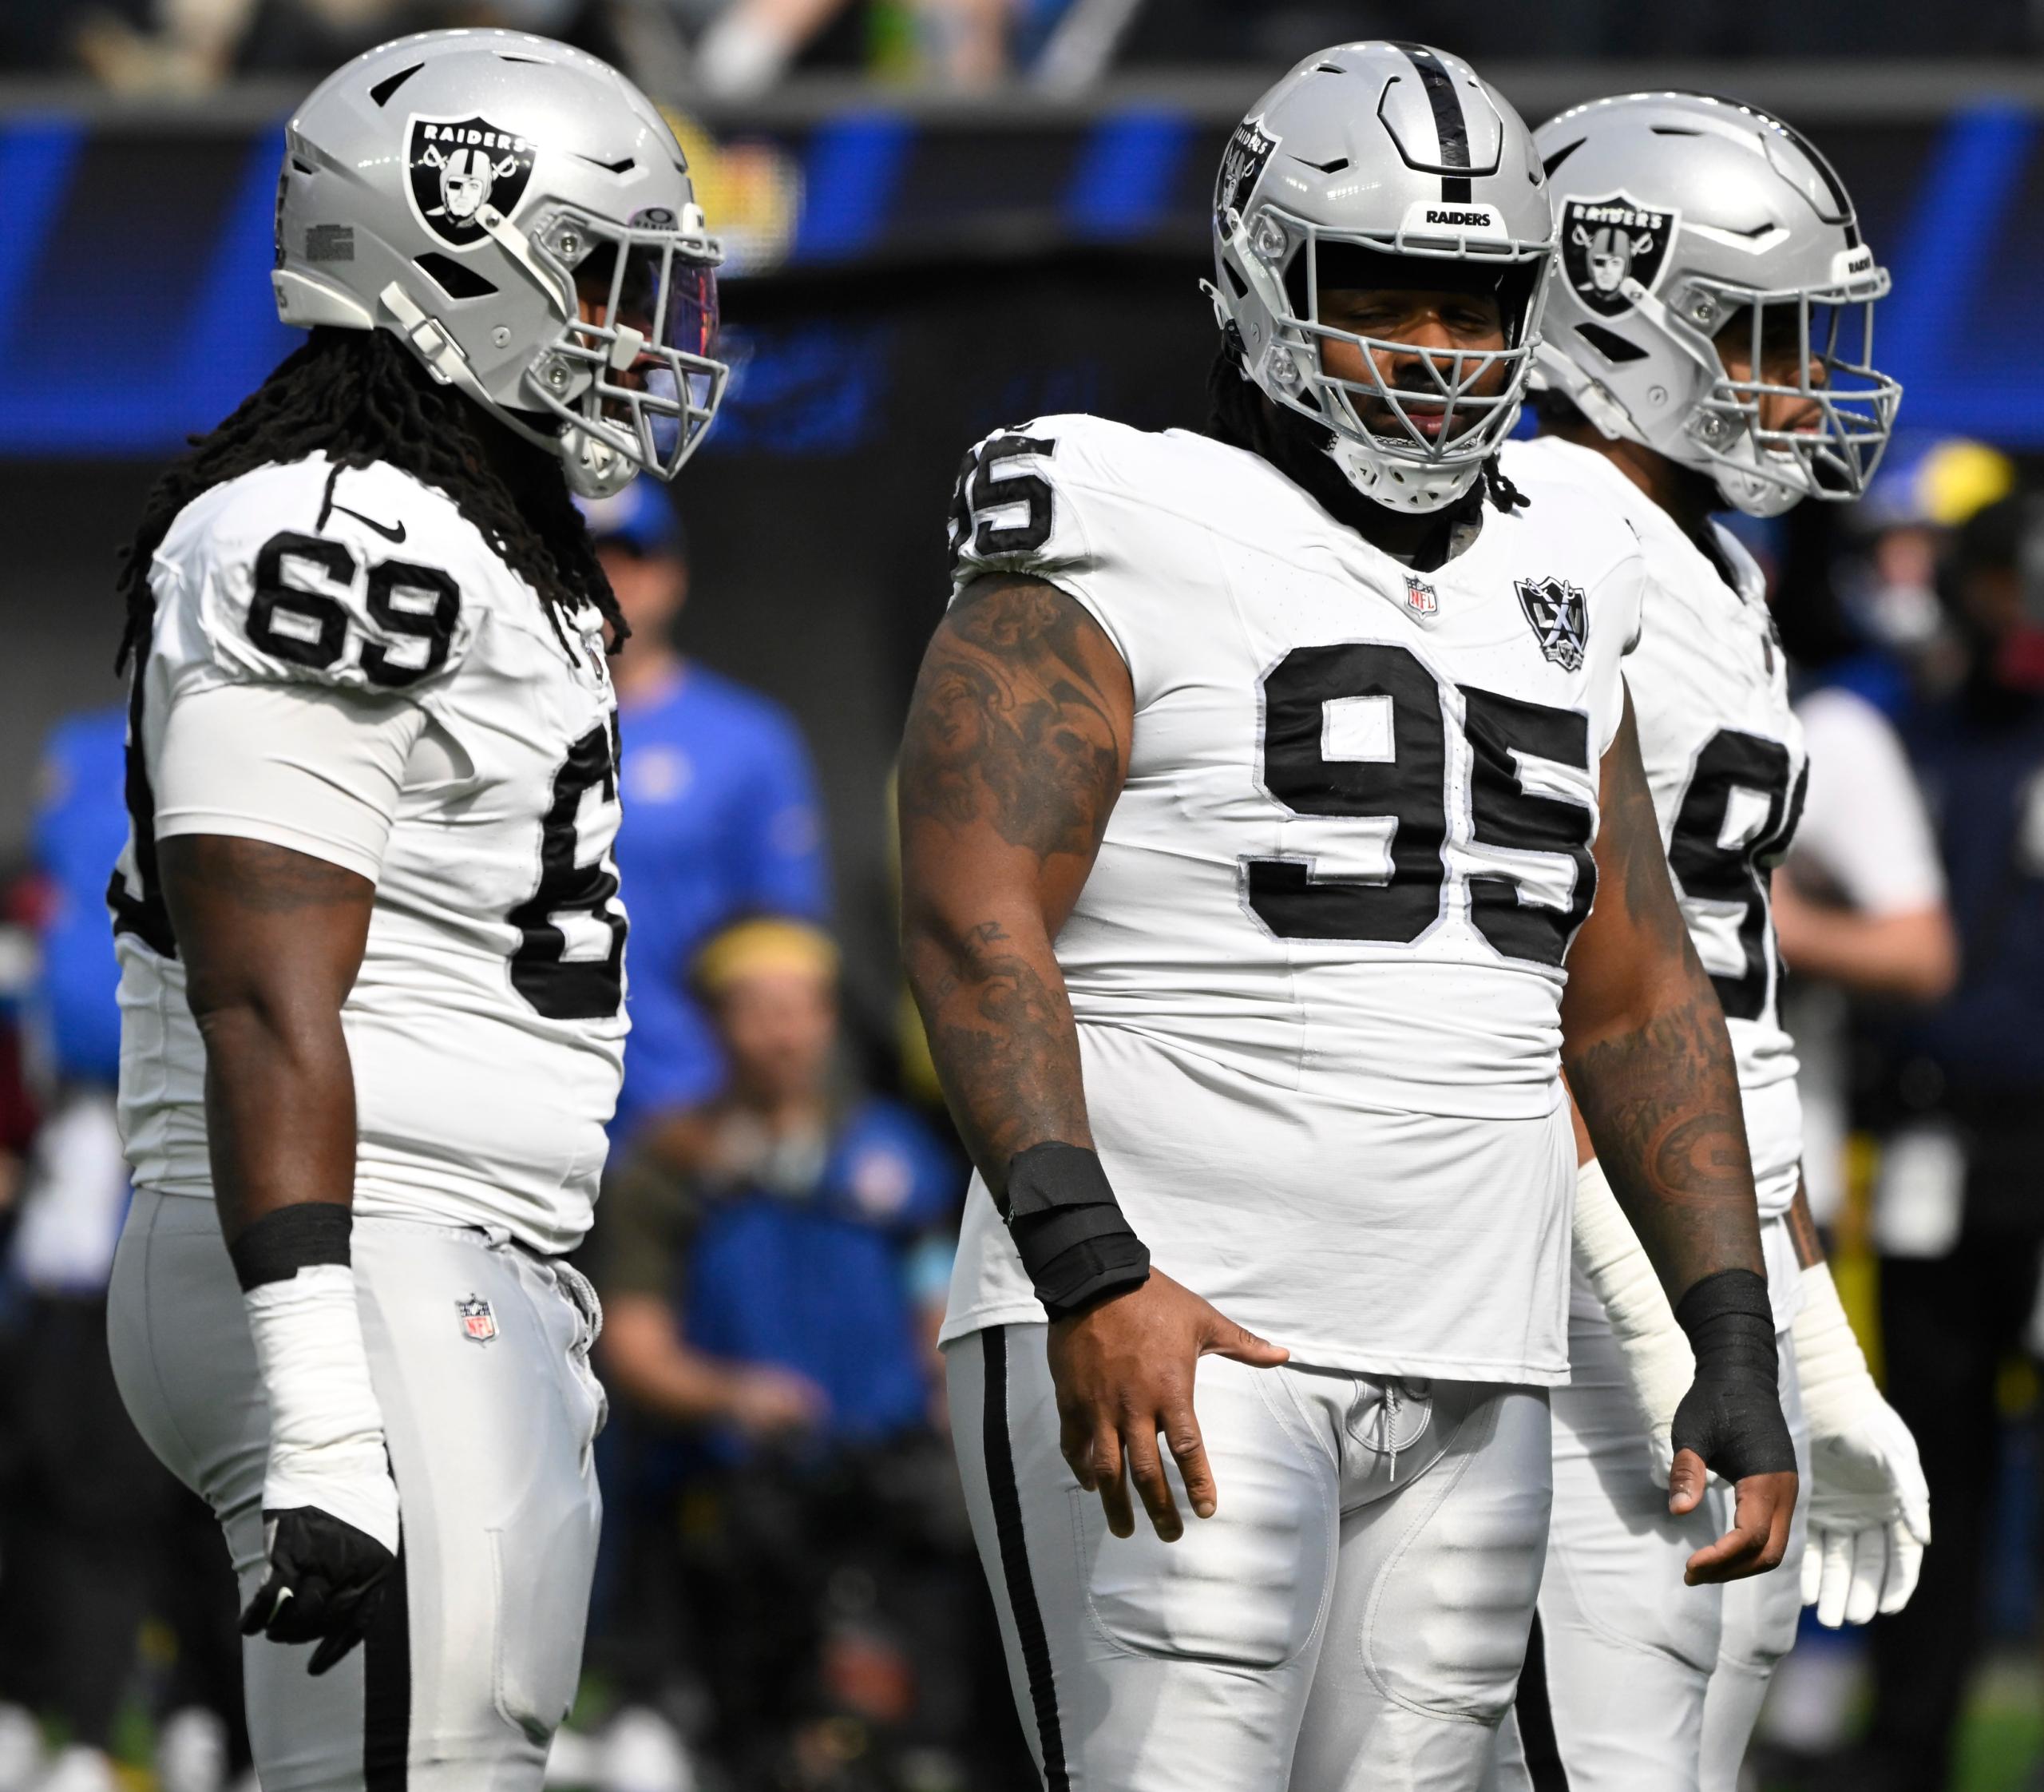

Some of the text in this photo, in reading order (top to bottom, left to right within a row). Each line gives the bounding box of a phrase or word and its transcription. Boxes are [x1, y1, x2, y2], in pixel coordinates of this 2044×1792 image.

[424, 125, 526, 152] RAIDERS
[1426, 210, 1491, 226] RAIDERS
[1573, 204, 1662, 229] RAIDERS
[246, 532, 460, 687] 69
[1411, 589, 1434, 609] NFL
[1248, 642, 1597, 965] 95
